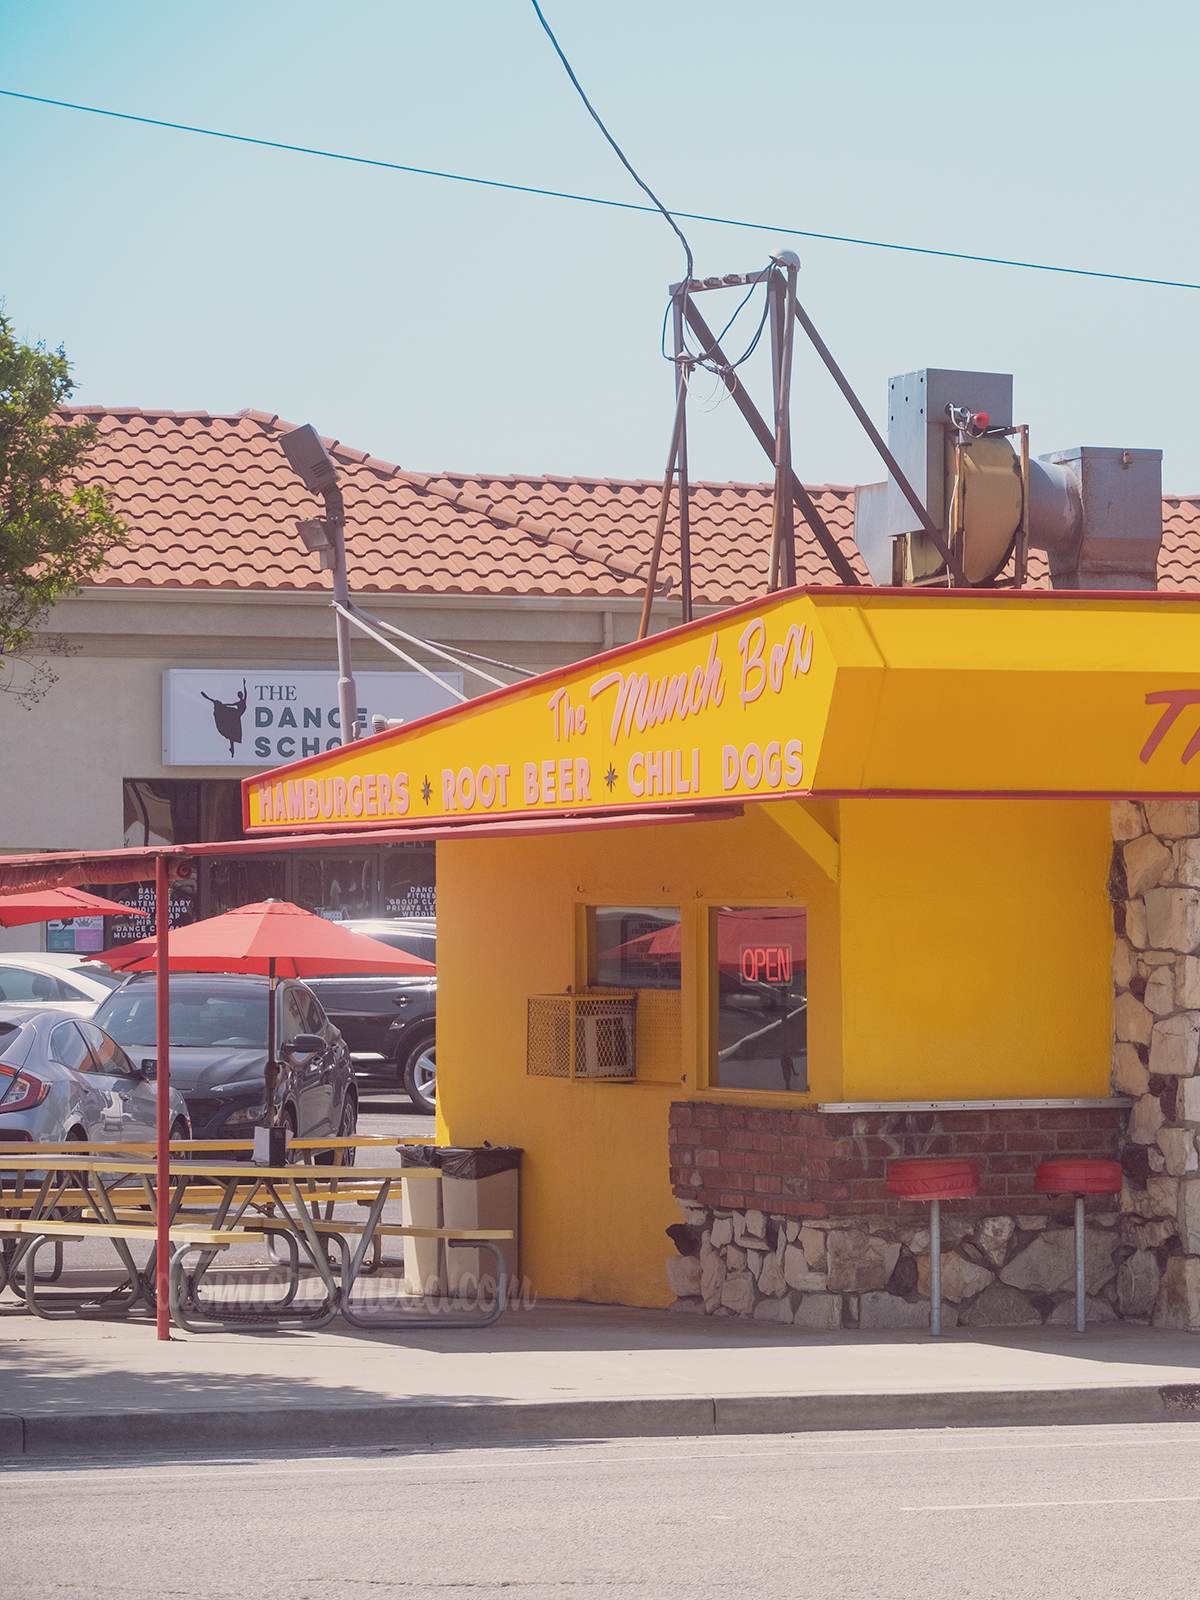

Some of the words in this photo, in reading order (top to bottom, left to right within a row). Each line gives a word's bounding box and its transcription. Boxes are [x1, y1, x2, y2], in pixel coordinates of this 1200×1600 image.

[254, 685, 298, 701] THE
[547, 686, 588, 741] The
[589, 631, 727, 746] Munch
[737, 616, 814, 712] Box
[254, 706, 368, 728] DANCE
[258, 772, 411, 822] HAMBURGERS
[441, 763, 511, 811] ROOT
[523, 757, 592, 805] BEER
[627, 747, 701, 798] CHILI
[721, 738, 804, 791] DOGS
[742, 948, 790, 981] OPEN
